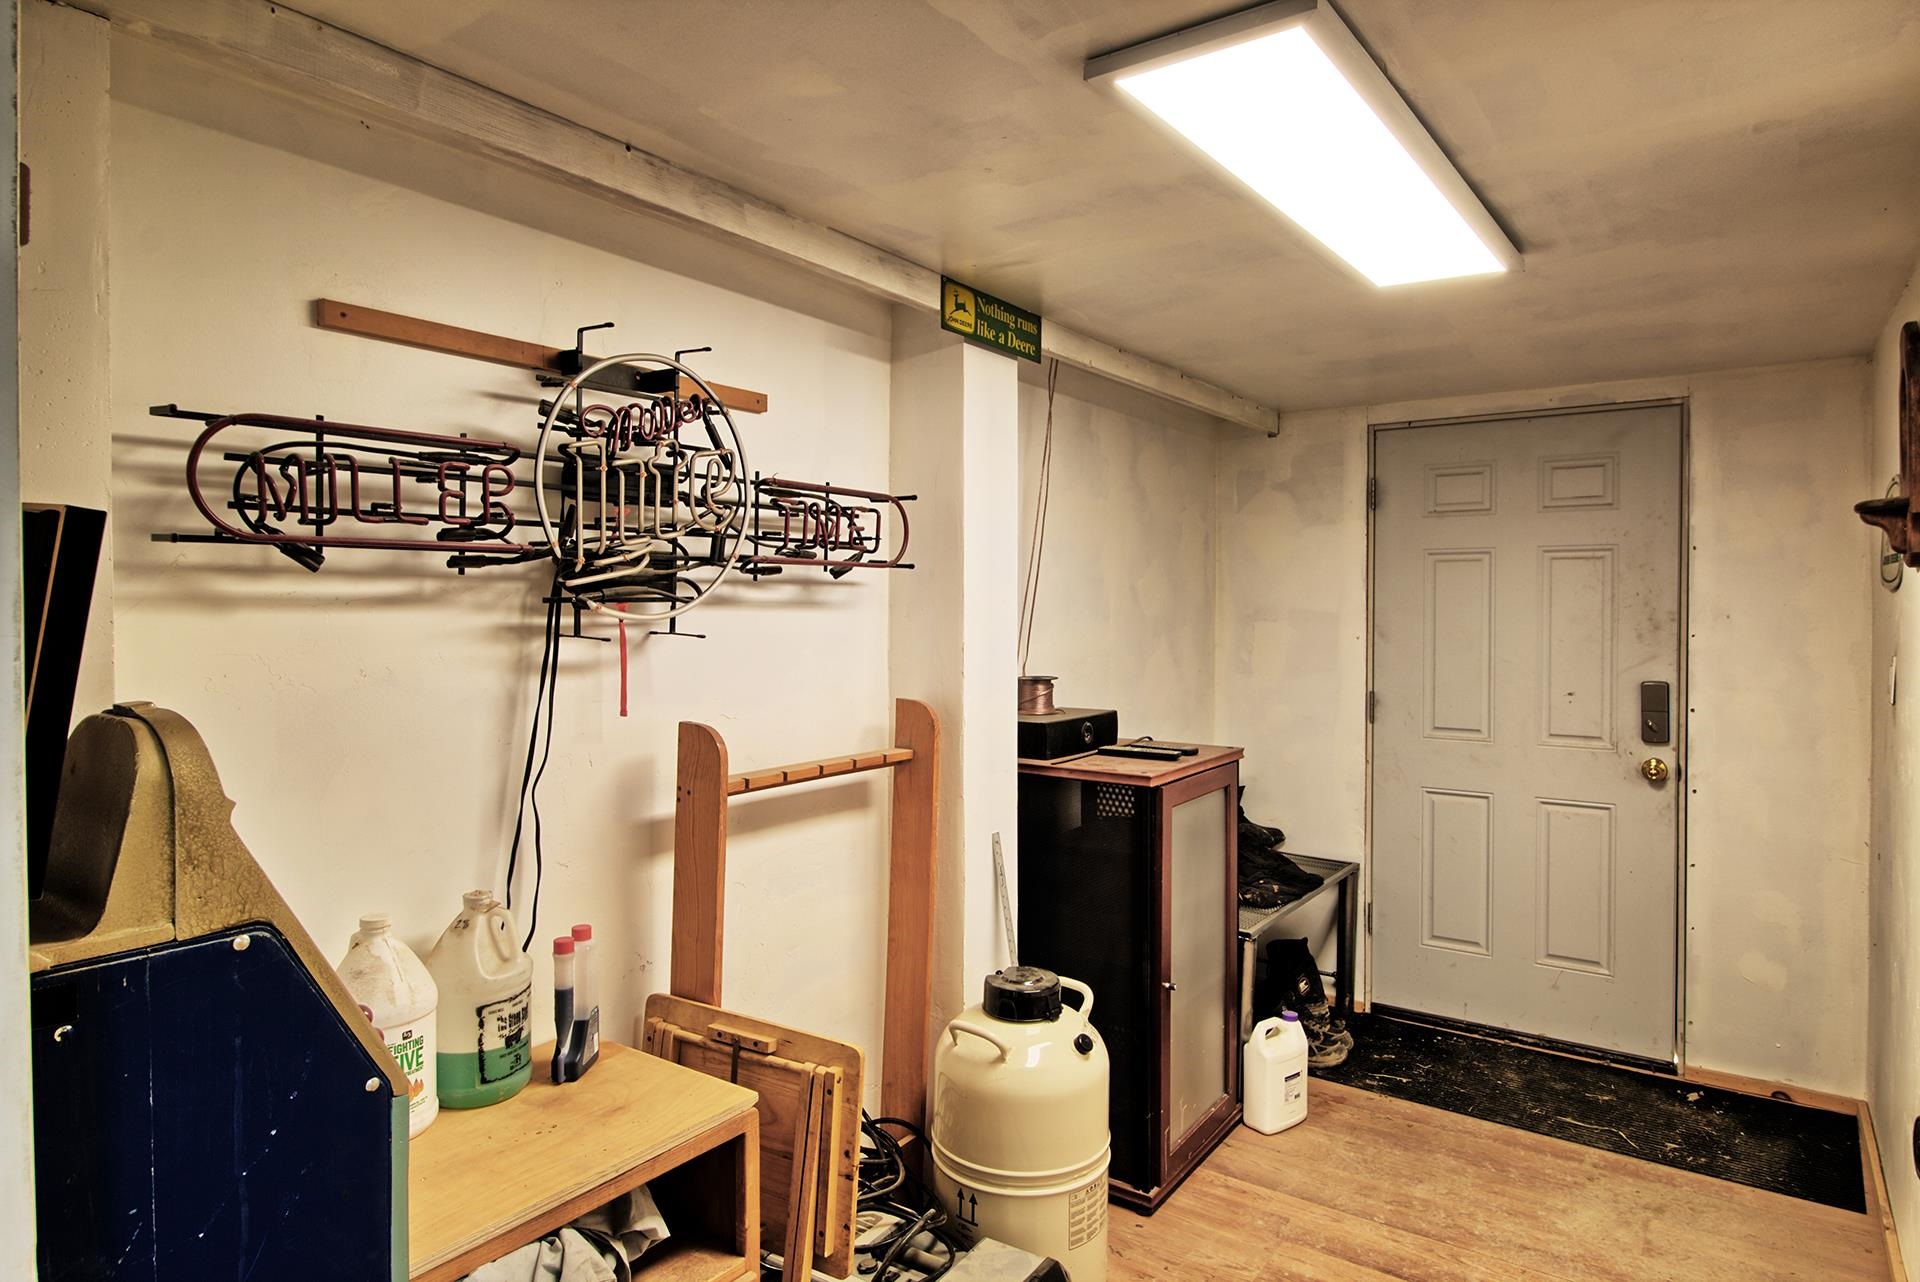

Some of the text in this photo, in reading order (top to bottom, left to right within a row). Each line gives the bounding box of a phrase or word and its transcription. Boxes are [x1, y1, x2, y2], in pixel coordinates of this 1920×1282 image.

[977, 296, 1038, 335] Nothing runs
[977, 318, 1036, 356] like a Deere
[251, 451, 516, 527] MILLER
[394, 1046, 424, 1070] IVE
